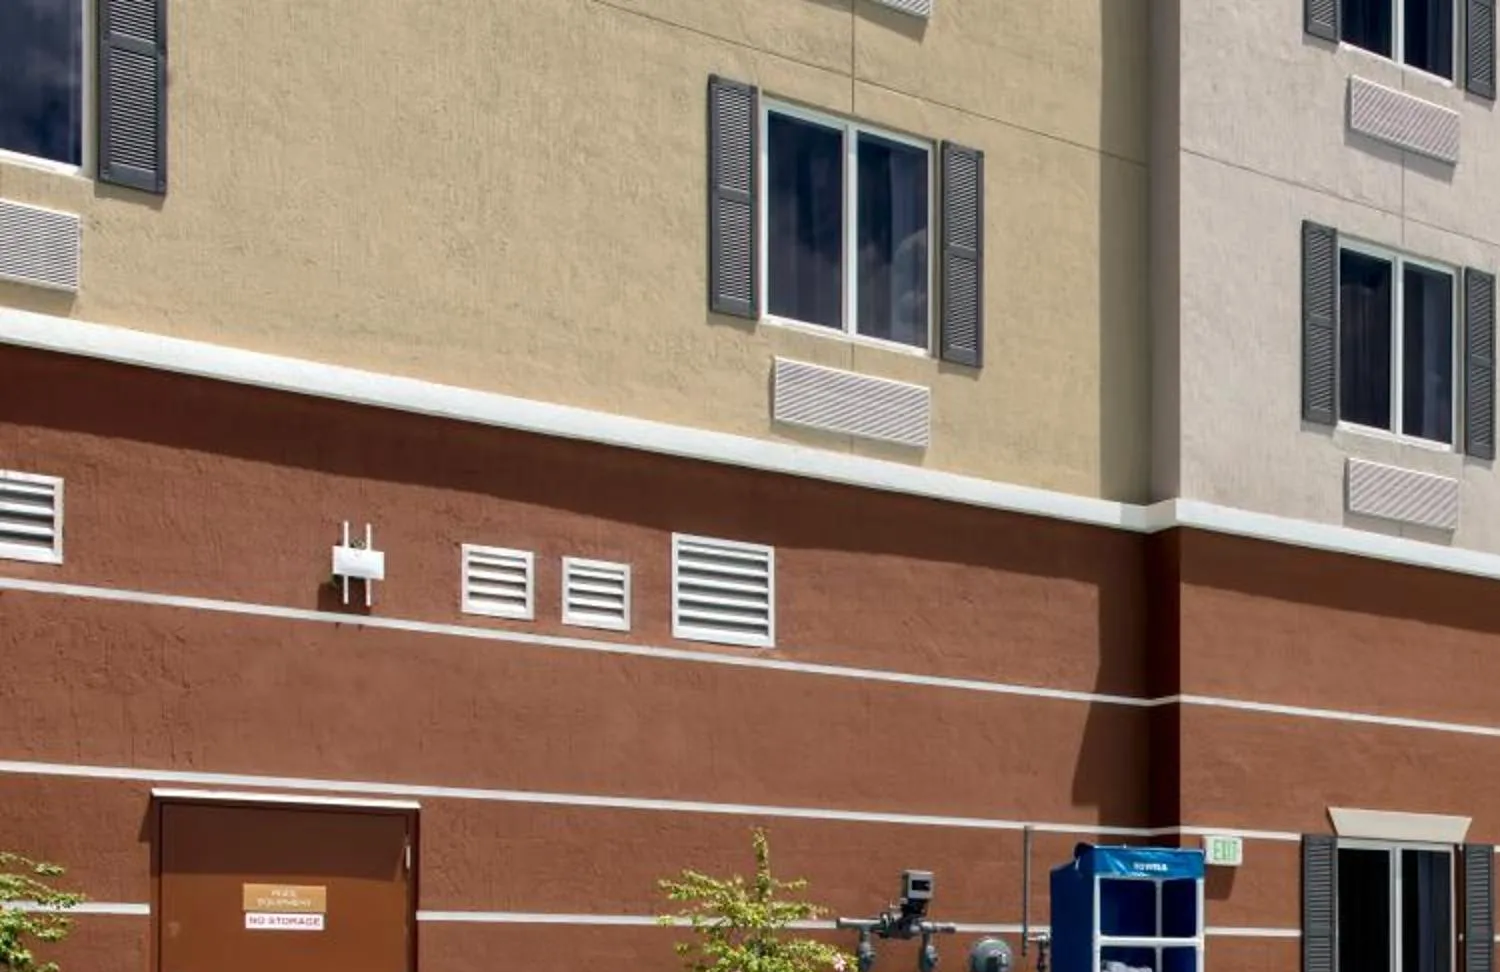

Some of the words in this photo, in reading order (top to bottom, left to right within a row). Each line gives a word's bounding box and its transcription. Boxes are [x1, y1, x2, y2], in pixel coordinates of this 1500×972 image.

[1213, 839, 1239, 861] EXIT
[249, 916, 265, 927] NO
[268, 916, 321, 927] STORAGE
